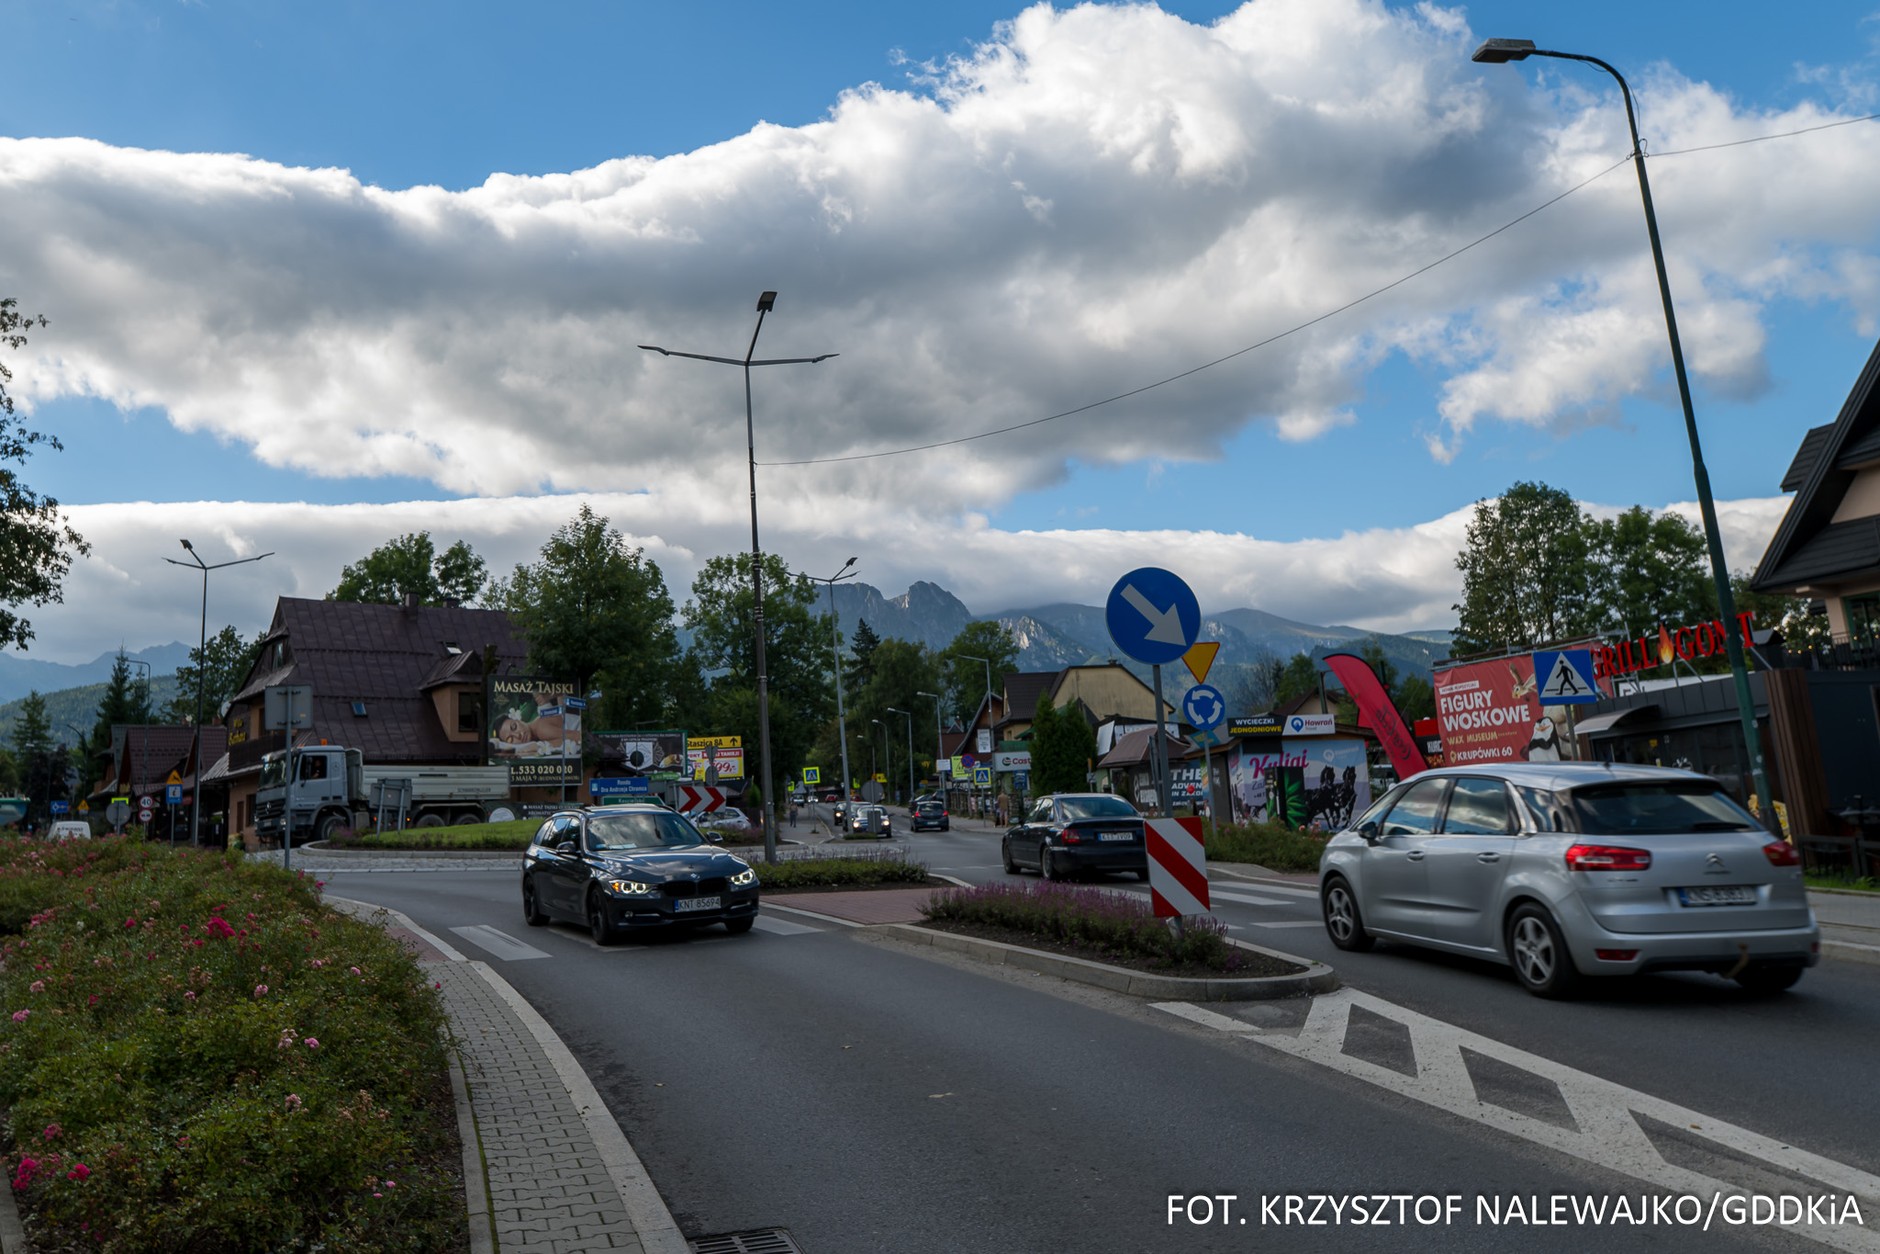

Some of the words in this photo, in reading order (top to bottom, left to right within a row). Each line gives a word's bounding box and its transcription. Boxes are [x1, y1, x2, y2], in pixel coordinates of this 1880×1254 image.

[1591, 637, 1659, 680] GRILL
[493, 680, 533, 693] MASAŻ
[535, 681, 574, 695] TAJSKI
[1441, 689, 1493, 714] FIGURY
[1235, 717, 1275, 726] WYCIECZKI
[1443, 703, 1531, 732] WOSKOWE
[1229, 725, 1282, 734] JEDNODNIOWE
[714, 738, 723, 746] 8A
[1446, 735, 1465, 746] WAX
[1466, 731, 1498, 744] MUSEUM
[1456, 747, 1500, 761] KRUPÓWKI
[1501, 746, 1513, 757] 60
[537, 765, 555, 774] 020
[1170, 769, 1202, 780] THE
[141, 798, 150, 806] 40
[679, 900, 694, 910] KNT
